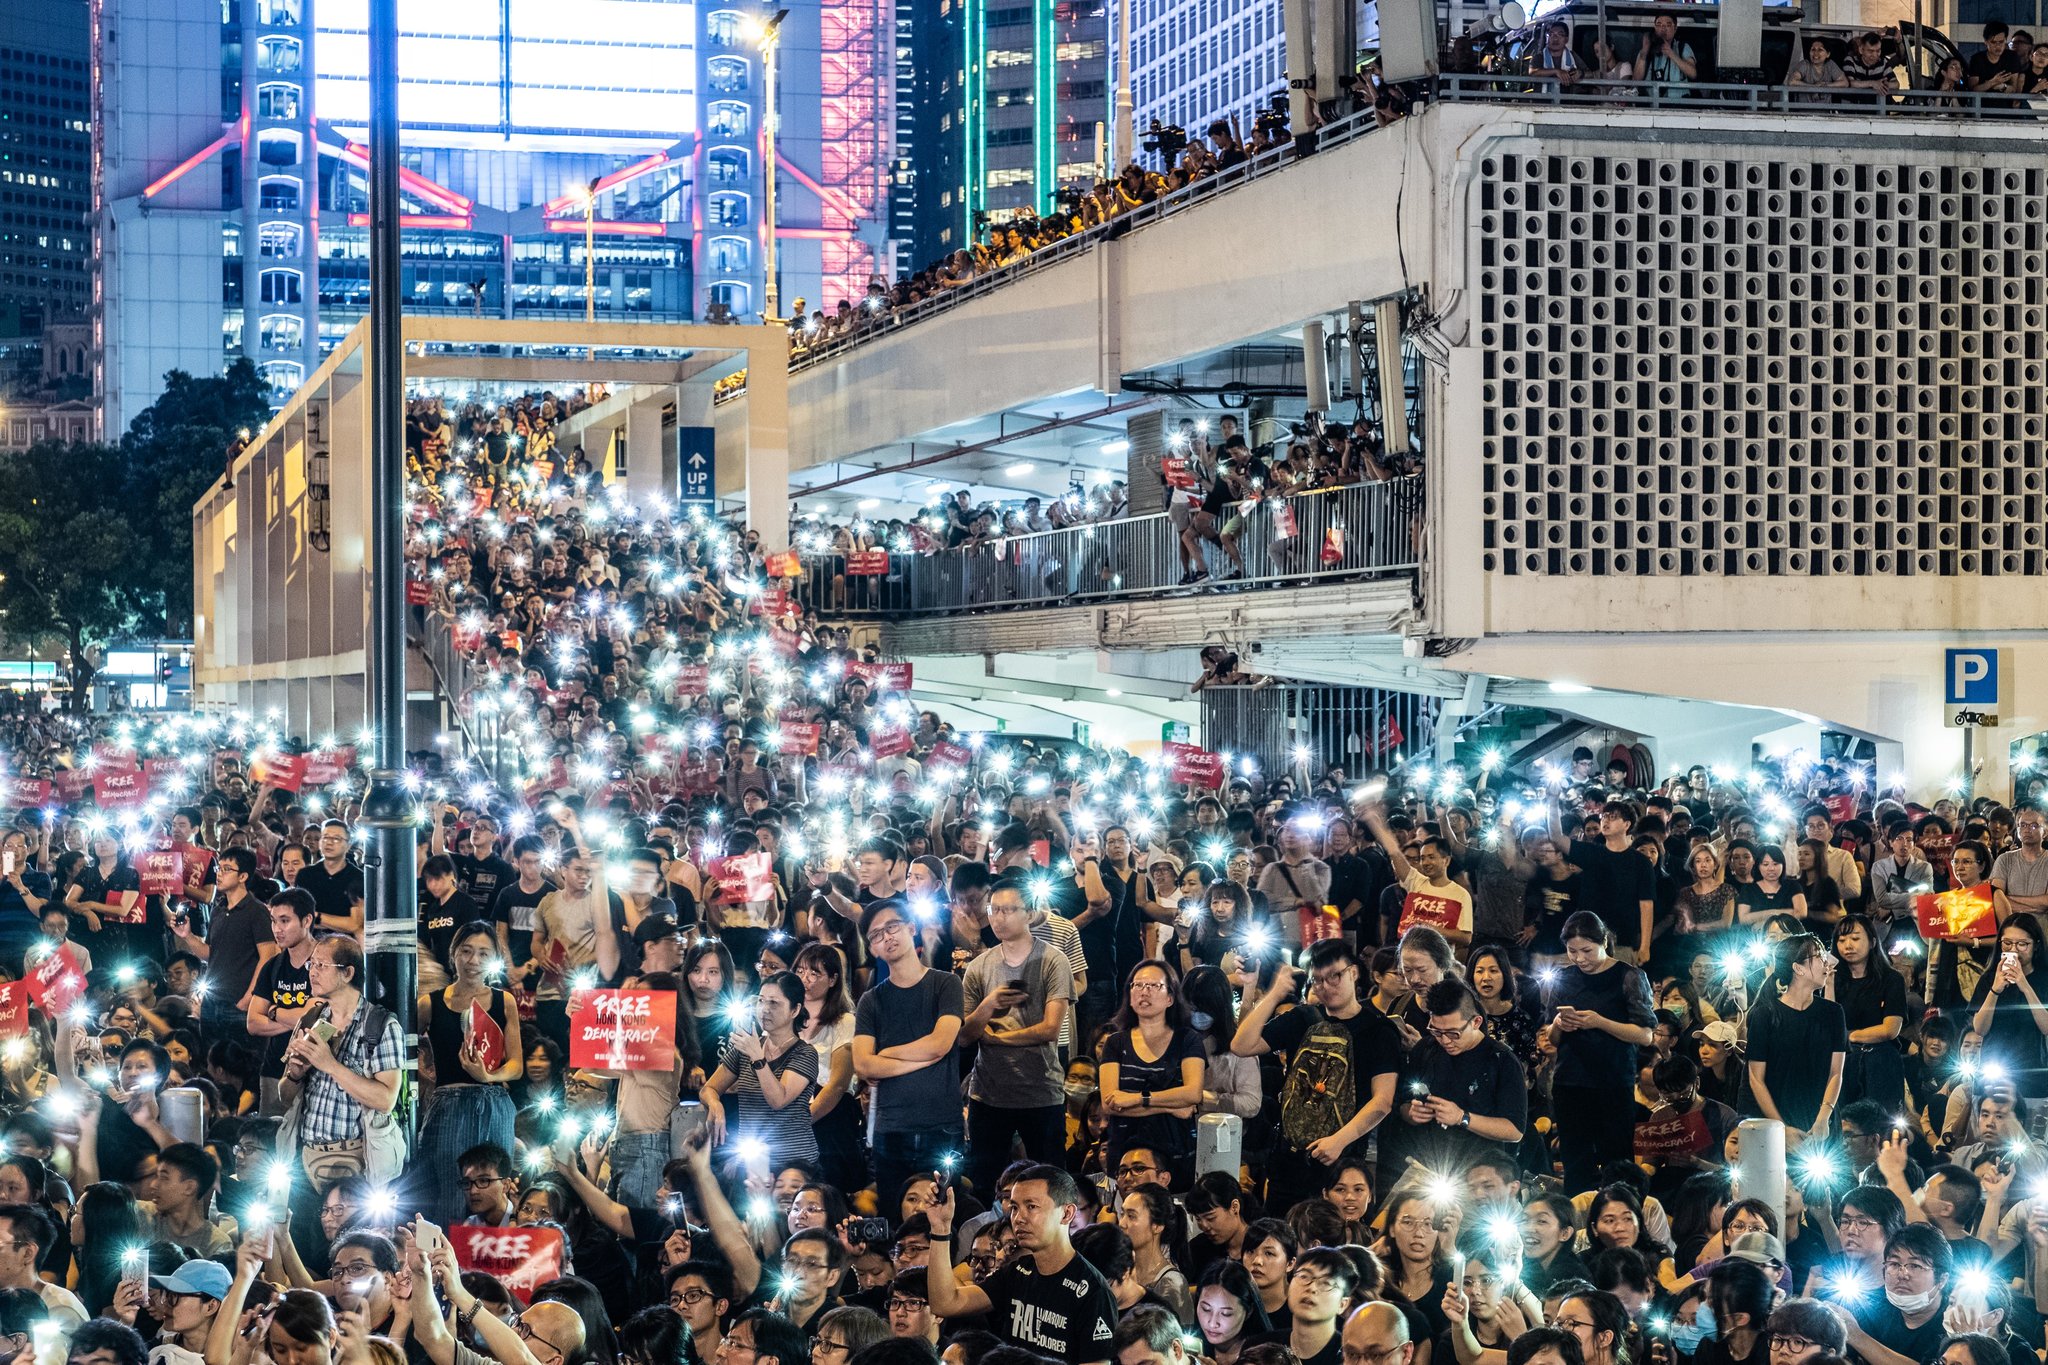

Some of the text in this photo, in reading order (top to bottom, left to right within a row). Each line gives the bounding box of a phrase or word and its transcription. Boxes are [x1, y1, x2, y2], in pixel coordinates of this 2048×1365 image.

[687, 472, 708, 485] UP
[1954, 654, 1989, 699] P
[1184, 752, 1214, 765] FREE
[1178, 765, 1217, 777] DEMOCRACY
[12, 780, 41, 792] FREE
[104, 774, 135, 788] FREE
[101, 788, 140, 799] DEMOCRACY
[1921, 835, 1953, 848] FREE
[146, 854, 174, 868] FREE
[1412, 896, 1447, 914] FREE
[428, 916, 454, 930] adidas
[592, 993, 652, 1019] FREE
[1634, 1119, 1686, 1138] FREE
[1633, 1131, 1696, 1149] DEMOCRACY
[467, 1230, 533, 1261] FREE
